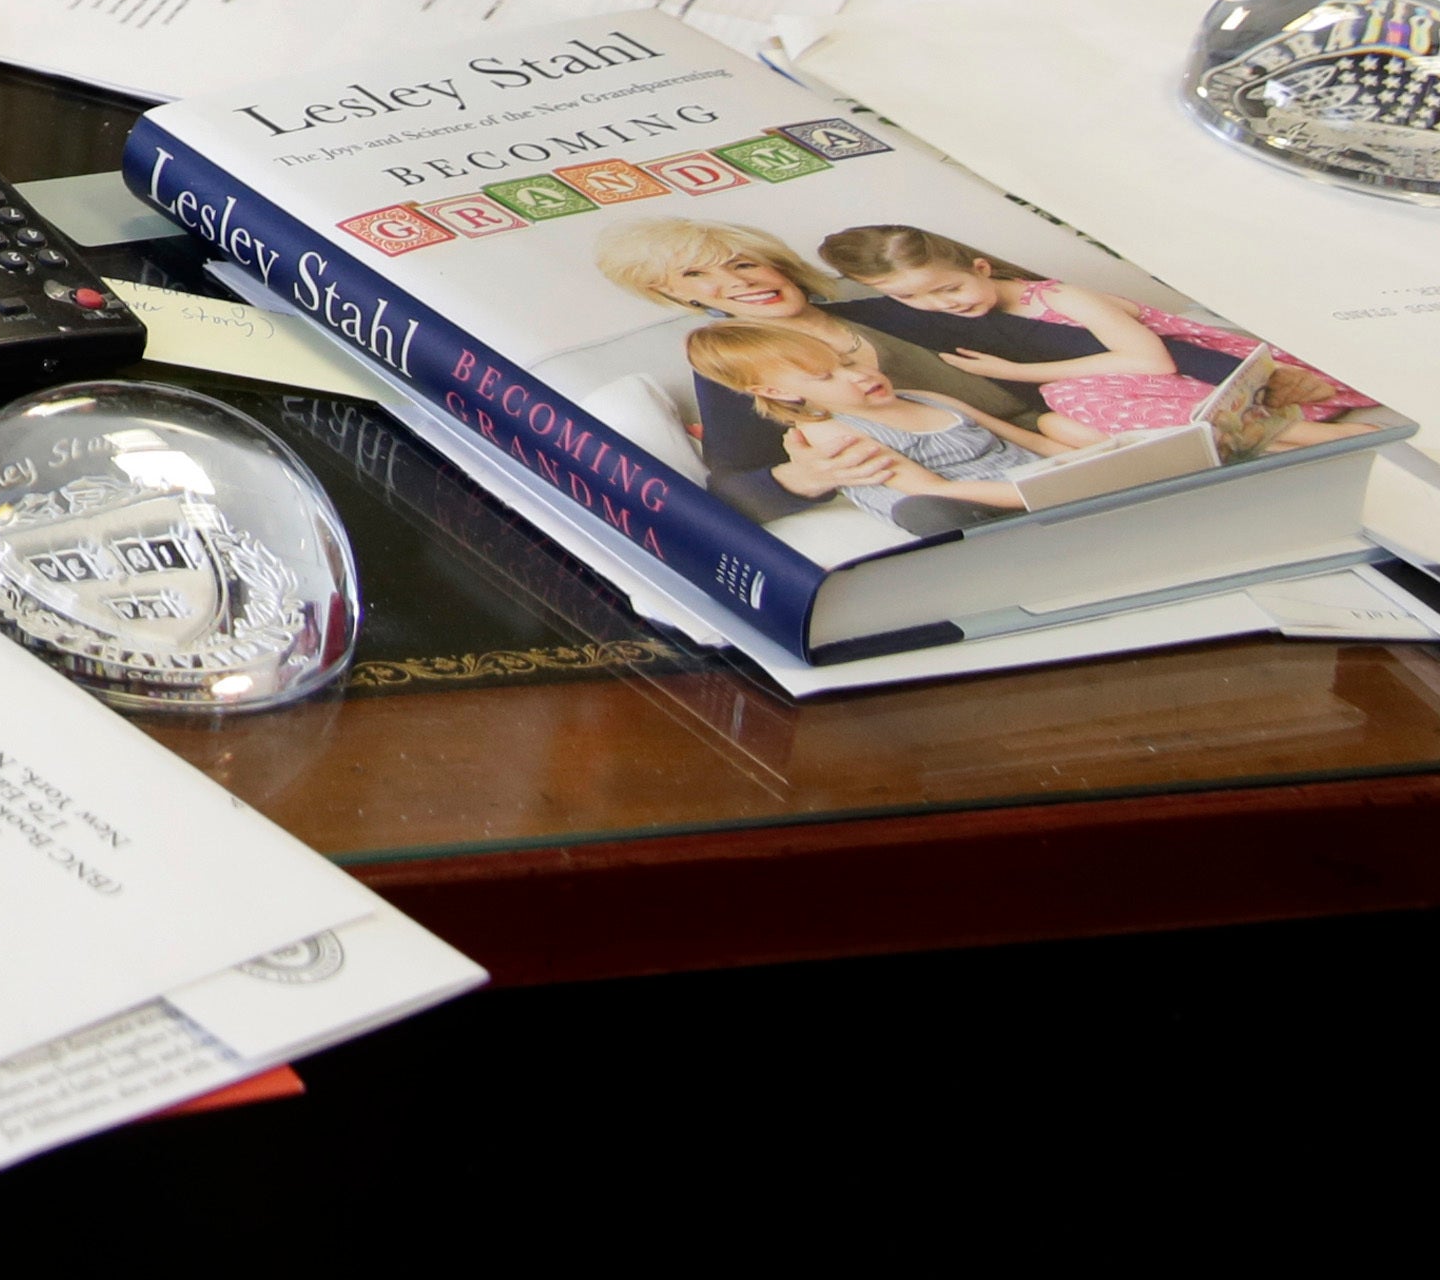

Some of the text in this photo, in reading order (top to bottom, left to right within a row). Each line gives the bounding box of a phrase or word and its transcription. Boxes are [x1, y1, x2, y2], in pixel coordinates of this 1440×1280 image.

[233, 31, 667, 138] Lesley Stahl
[274, 148, 319, 170] The
[320, 137, 365, 164] Joys
[366, 130, 403, 151] and
[406, 119, 477, 146] Science
[502, 104, 533, 124] the
[533, 94, 580, 117] New
[581, 65, 732, 109] Grandparenting
[369, 117, 872, 242] GRANDMA
[383, 103, 721, 187] BECOMING
[145, 146, 280, 282] Lesley
[292, 250, 421, 379] Stahl
[451, 347, 671, 515] BECOMING
[444, 389, 667, 560] GRANDMA
[715, 552, 730, 584] blue
[23, 766, 72, 811] York,
[27, 801, 67, 832] 176
[75, 811, 131, 849] New
[47, 848, 123, 898] (BNC
